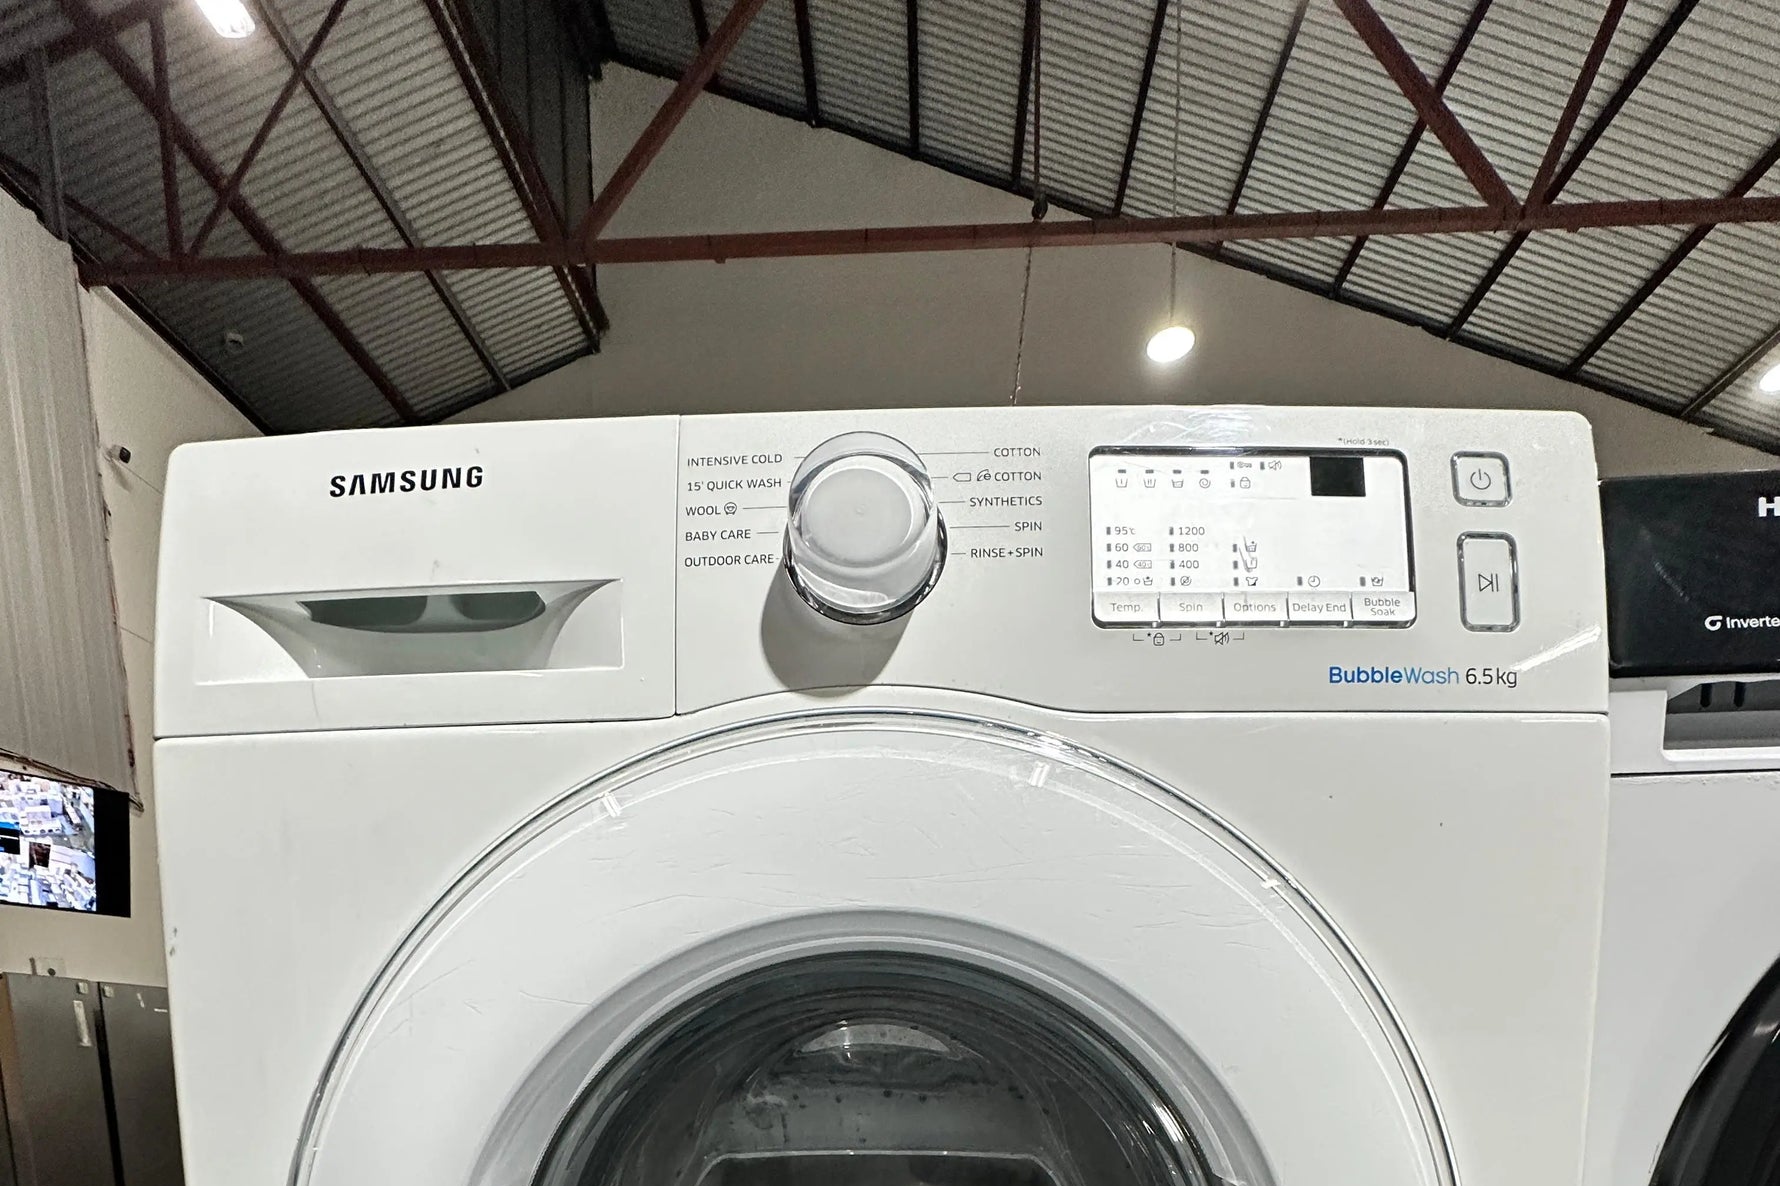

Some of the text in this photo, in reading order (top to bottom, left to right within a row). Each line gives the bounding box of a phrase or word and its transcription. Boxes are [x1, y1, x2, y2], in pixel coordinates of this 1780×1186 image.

[993, 447, 1041, 457] COTTON
[687, 453, 783, 467] INTENSIVE COLD
[329, 465, 484, 498] SAMSUNG
[994, 471, 1042, 482] COTTON
[706, 479, 744, 492] QUICK
[746, 478, 782, 489] WASH
[969, 496, 1043, 507] SYNTHETICS
[1758, 496, 1780, 517] H
[685, 505, 721, 516] WOOL
[1014, 521, 1042, 532] SPIN
[1178, 526, 1205, 536] 1200
[685, 529, 751, 542] BABY CARE
[1115, 542, 1129, 552] 60
[1178, 542, 1199, 553] 800
[684, 553, 774, 568] OUTDOOR CARE
[1115, 559, 1129, 569] 40
[1179, 559, 1200, 569] 400
[1116, 576, 1130, 586] 20
[1111, 602, 1144, 614] Temp.
[1179, 602, 1204, 614] Spin
[1233, 602, 1277, 614] Options
[1292, 602, 1347, 614] Delay End
[1363, 597, 1401, 608] Bubble
[1370, 606, 1397, 617] Soak
[1726, 615, 1780, 629] Inverte
[1328, 665, 1460, 685] BubbleWash
